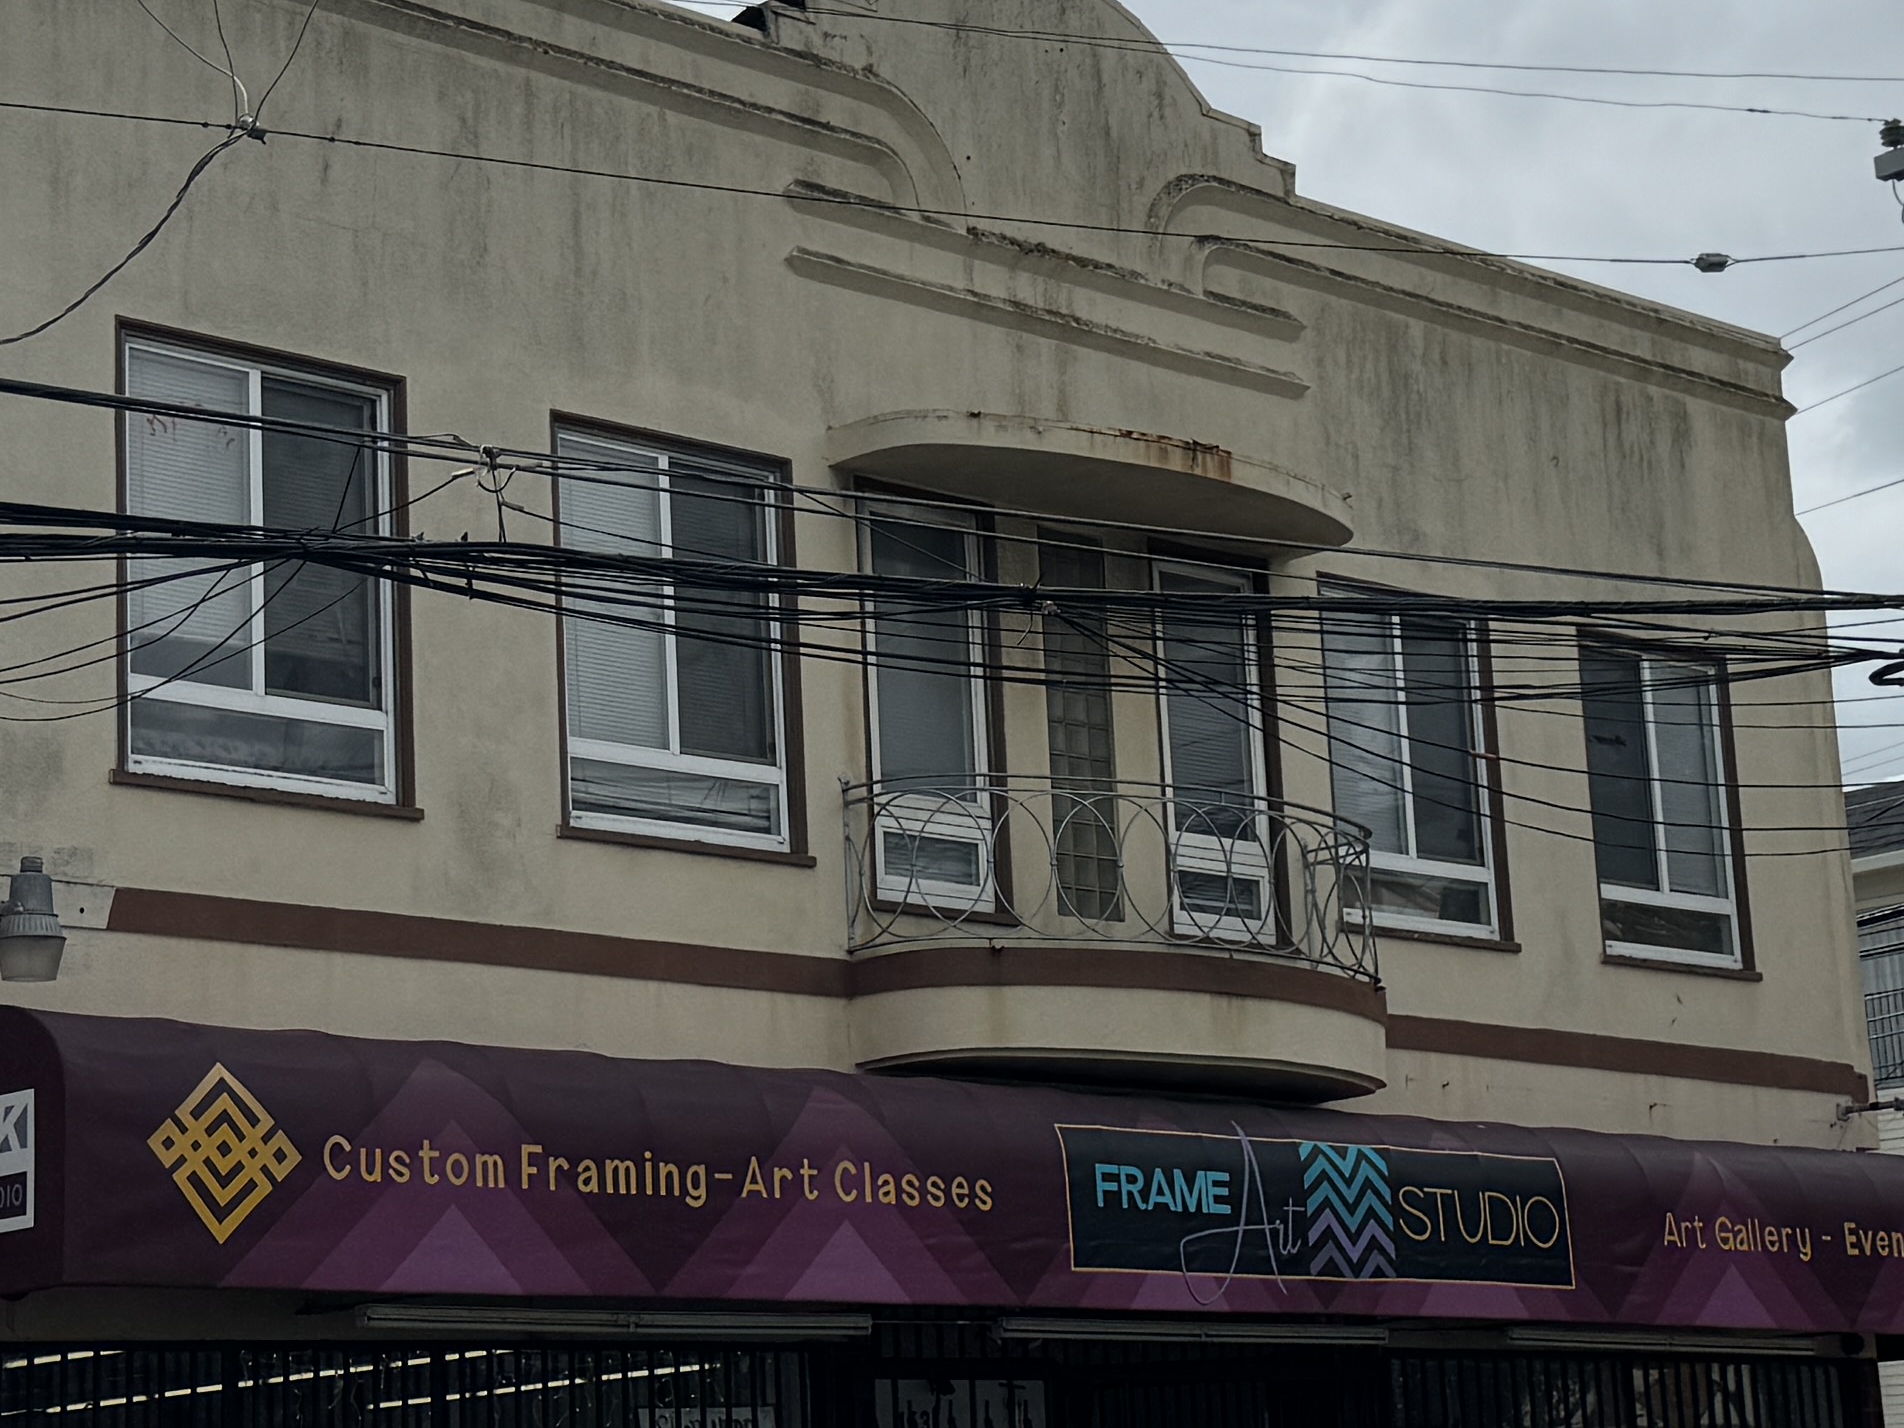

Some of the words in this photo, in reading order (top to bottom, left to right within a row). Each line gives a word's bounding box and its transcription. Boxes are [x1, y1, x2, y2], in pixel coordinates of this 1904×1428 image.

[322, 1133, 506, 1190] Custom
[833, 1159, 995, 1212] Classes
[1095, 1161, 1231, 1216] FRAME
[1180, 1119, 1304, 1305] Art
[1398, 1186, 1559, 1250] STUDIO
[1663, 1212, 1707, 1251] Art
[1712, 1214, 1813, 1264] Gallery
